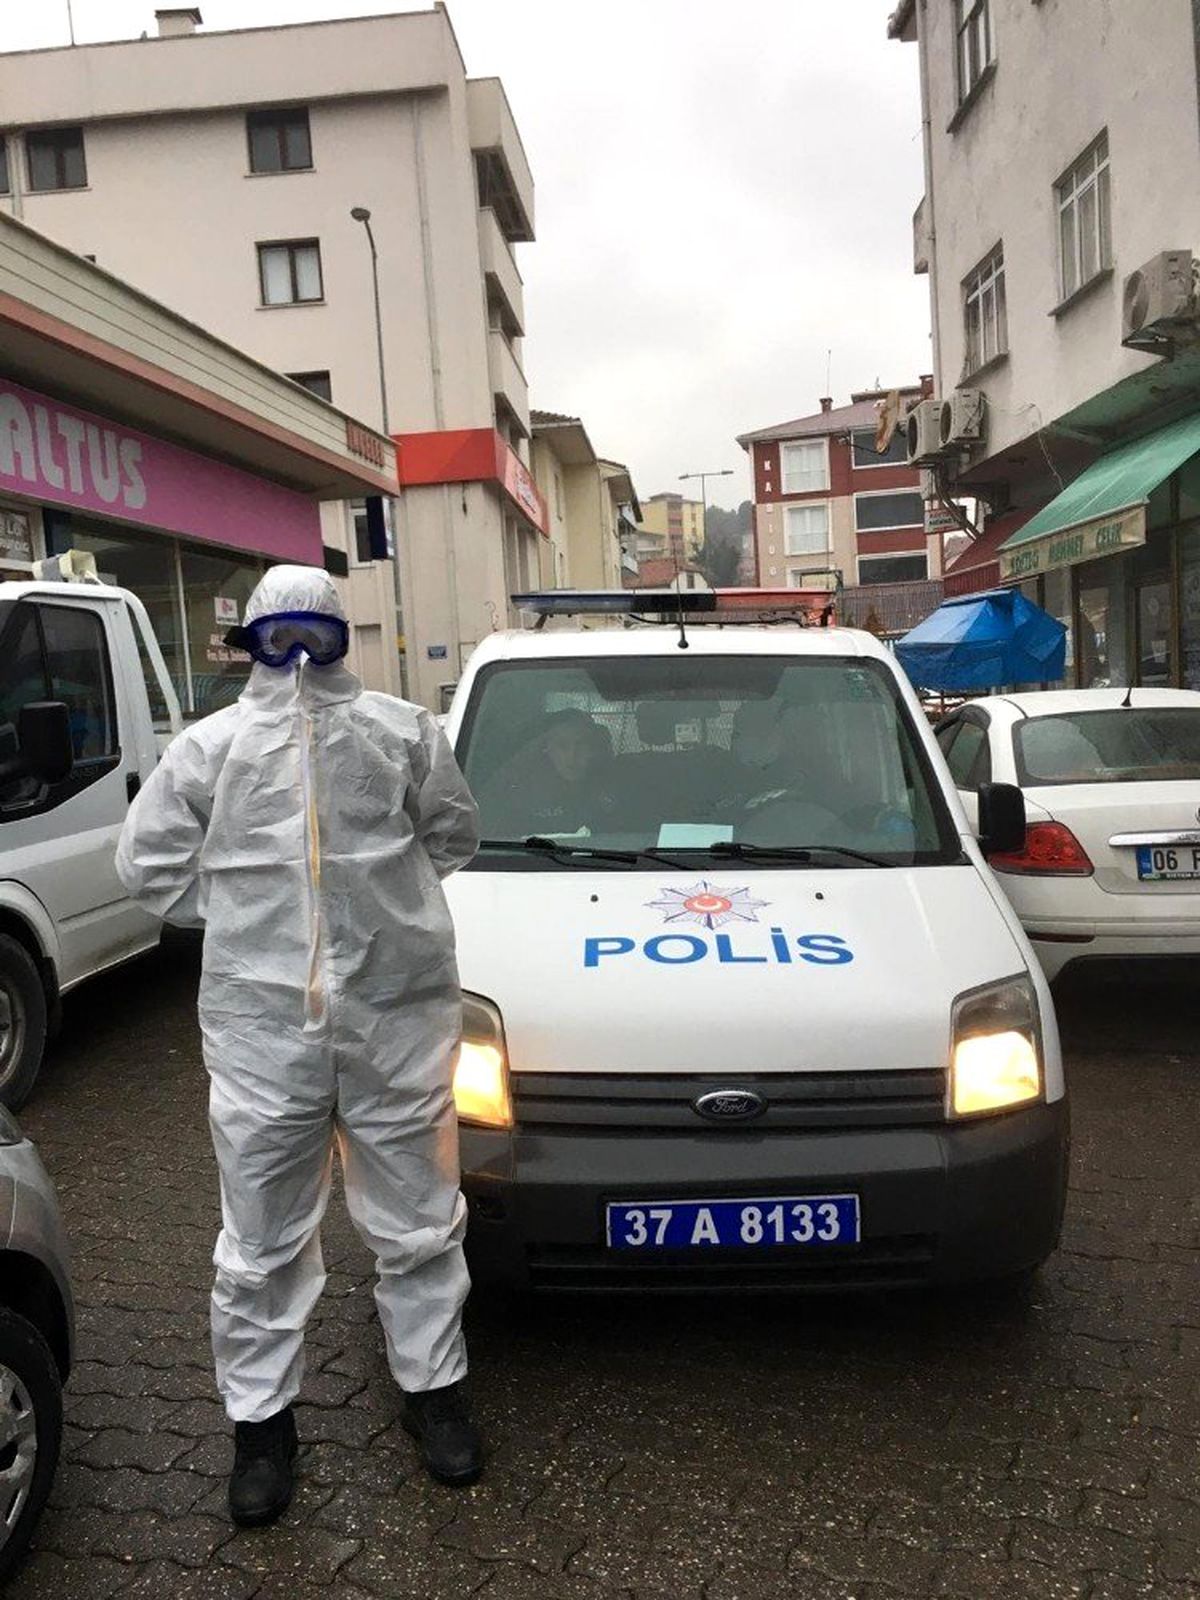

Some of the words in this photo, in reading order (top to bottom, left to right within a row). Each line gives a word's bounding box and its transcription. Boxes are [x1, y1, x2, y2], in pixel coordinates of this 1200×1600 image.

[0, 393, 147, 509] ALTUS
[1153, 849, 1178, 871] 06
[583, 927, 854, 967] POLİS
[712, 1097, 748, 1112] Ford
[624, 1208, 673, 1246] 37
[690, 1207, 721, 1245] A
[740, 1202, 841, 1244] 8133
